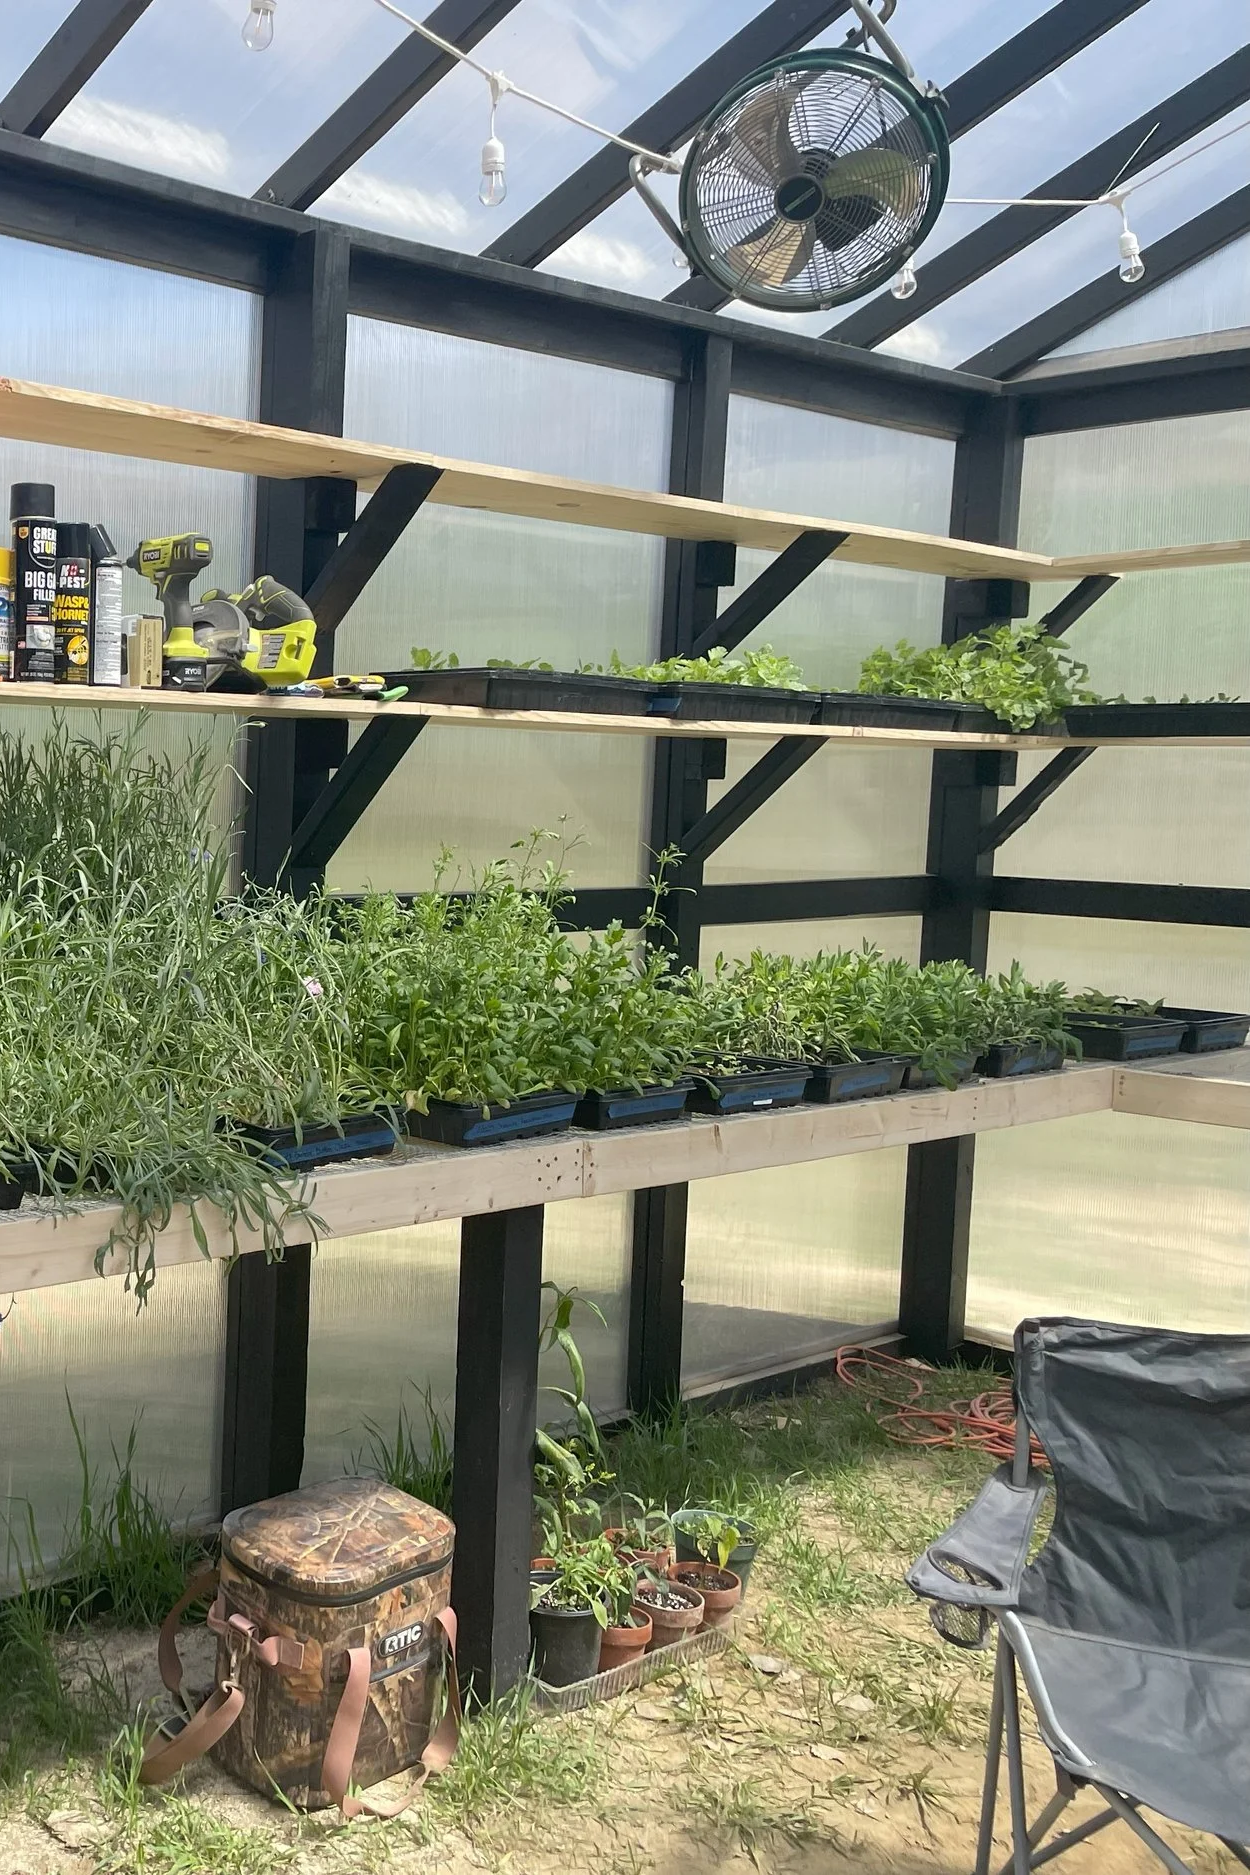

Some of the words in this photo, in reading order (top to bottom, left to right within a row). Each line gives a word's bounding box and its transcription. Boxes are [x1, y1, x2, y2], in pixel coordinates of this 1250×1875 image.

[33, 526, 57, 541] GREA
[33, 540, 57, 555] STUF
[143, 551, 160, 561] RYOBI
[24, 571, 46, 588] BIG
[59, 576, 86, 588] PEST
[33, 589, 55, 602] FILLE
[55, 608, 89, 621] HORNET
[385, 1625, 422, 1655] RTIC
